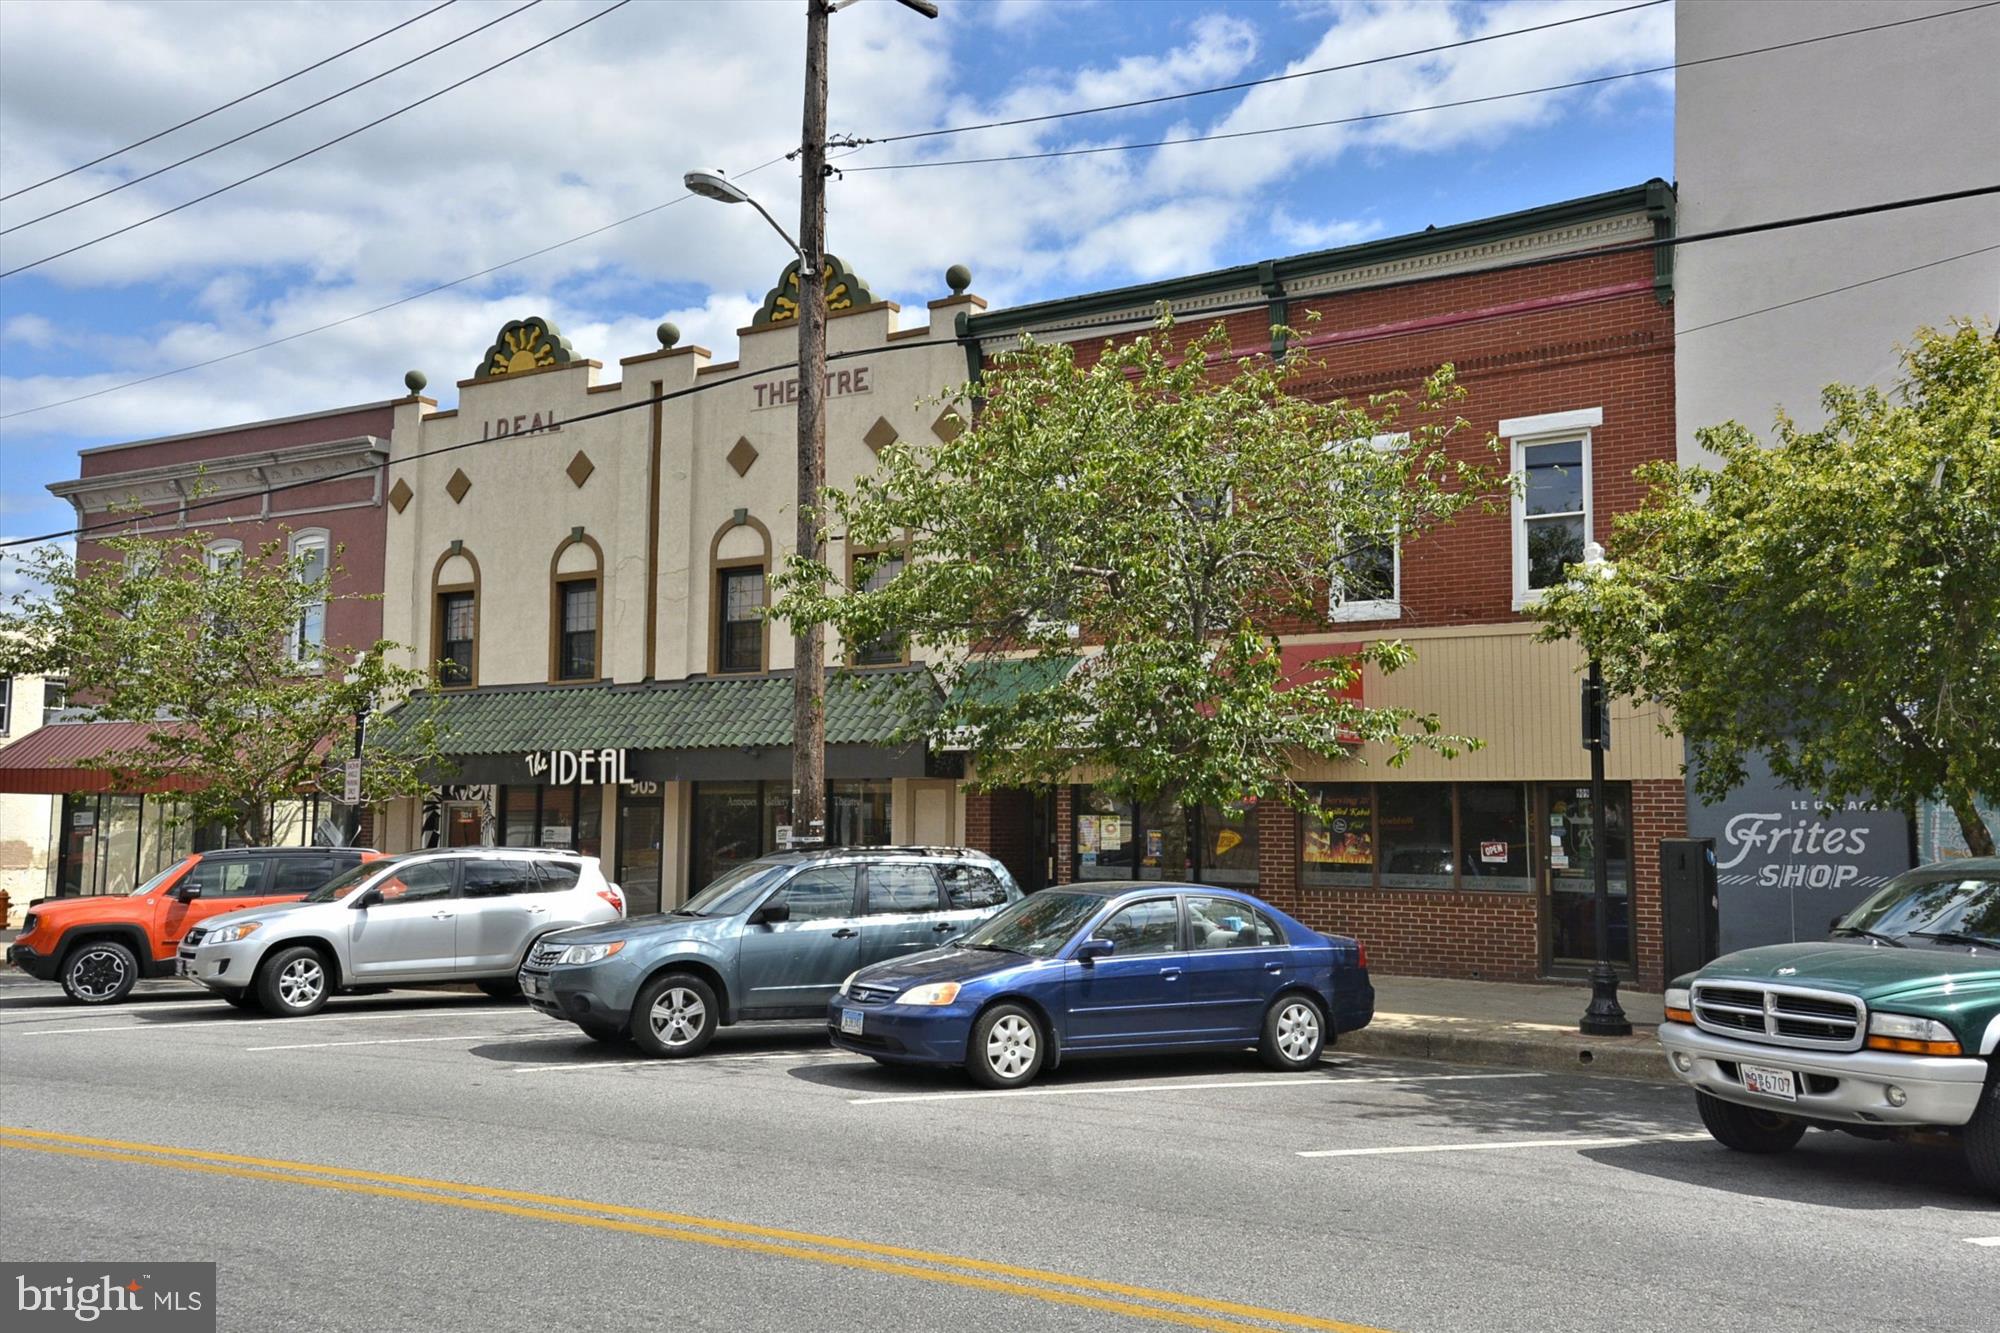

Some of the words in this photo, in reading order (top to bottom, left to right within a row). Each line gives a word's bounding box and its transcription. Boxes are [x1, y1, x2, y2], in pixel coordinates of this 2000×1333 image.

[753, 367, 869, 407] THETRE
[483, 409, 561, 441] IDEAL
[525, 751, 548, 782] The
[550, 748, 634, 785] IDEAL
[1791, 801, 1808, 810] LE
[1485, 844, 1504, 856] OPEN
[1717, 813, 1870, 869] Frites
[1758, 864, 1859, 889] SHOP
